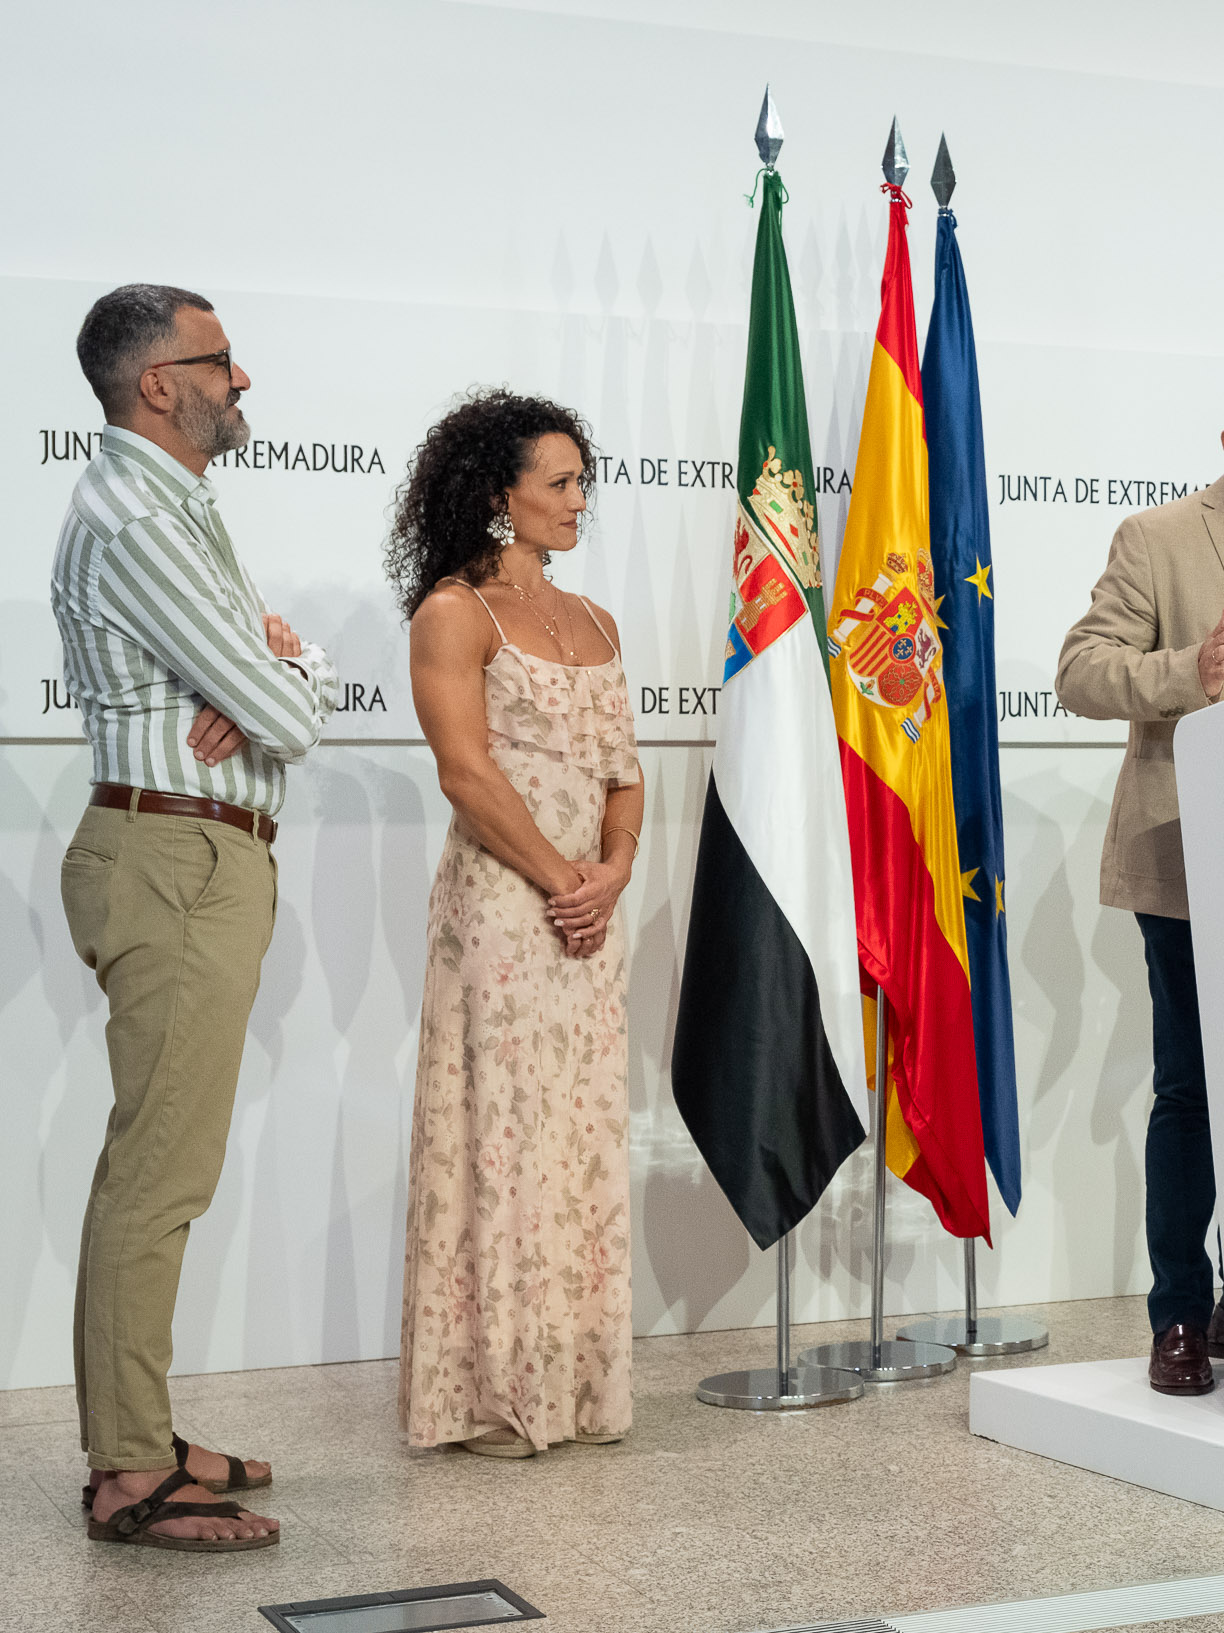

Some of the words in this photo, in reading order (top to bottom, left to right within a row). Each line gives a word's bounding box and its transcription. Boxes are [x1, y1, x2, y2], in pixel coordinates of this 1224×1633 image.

[39, 430, 103, 465] JUNT
[211, 440, 386, 474] REMADURA
[640, 457, 669, 486] DE
[998, 475, 1067, 505] JUNTA
[1075, 478, 1100, 504] DE
[1107, 479, 1211, 506] EXTREM
[640, 686, 670, 714] DE
[999, 691, 1069, 722] JUNTA
